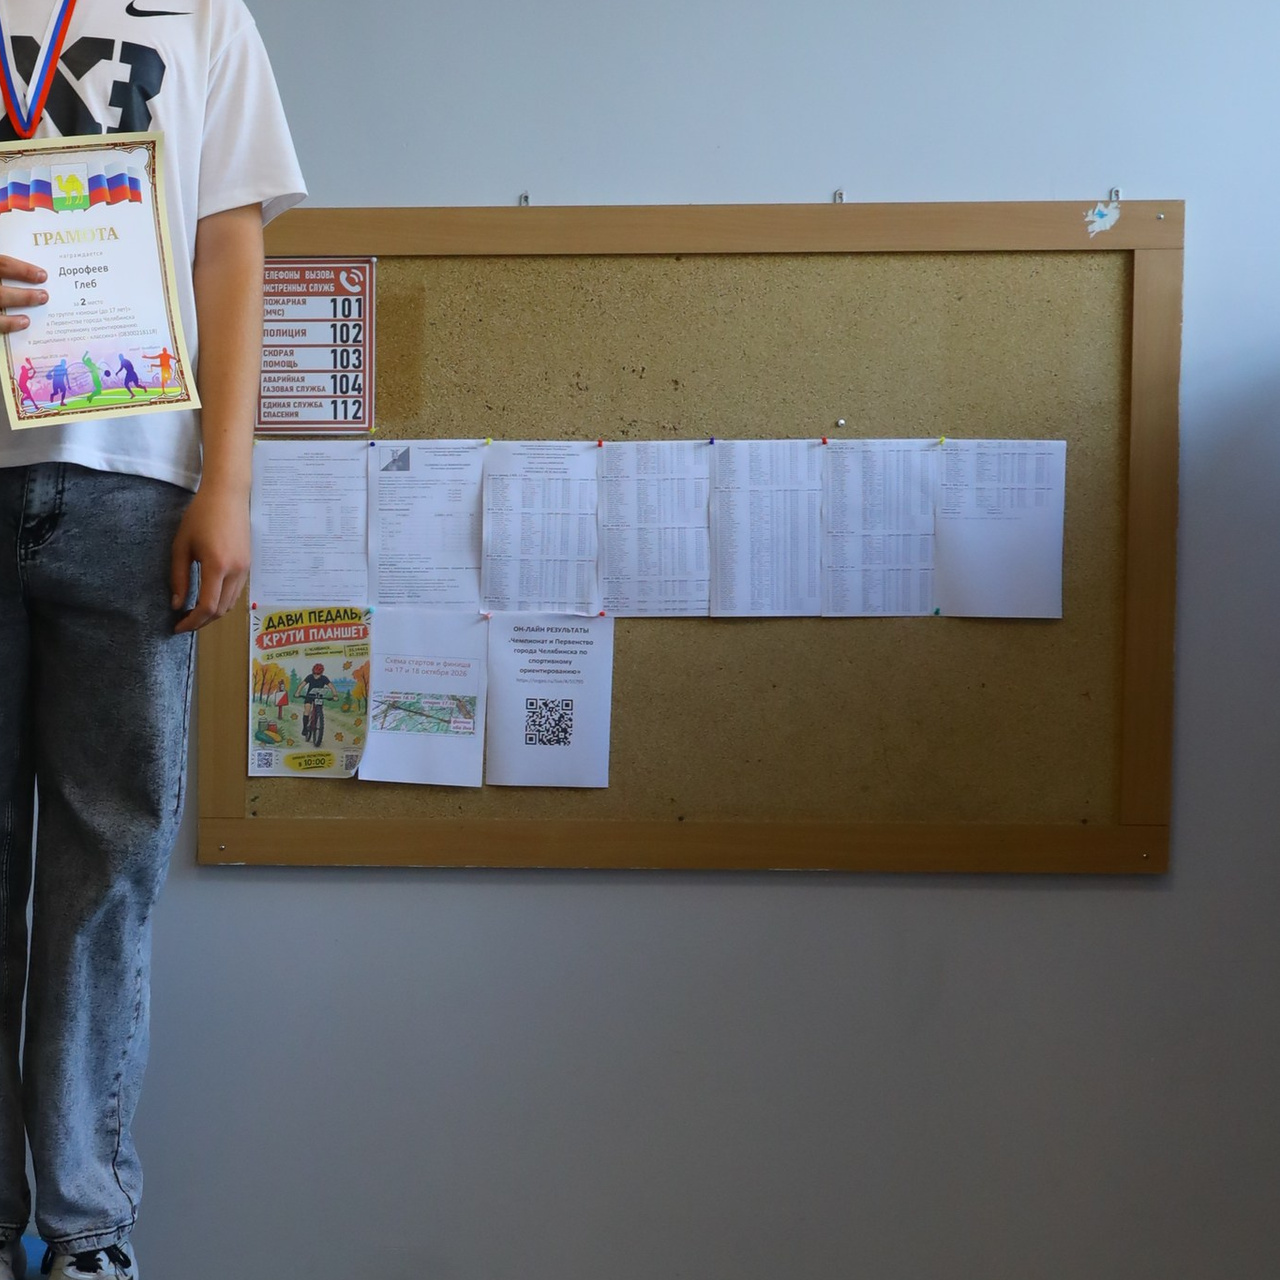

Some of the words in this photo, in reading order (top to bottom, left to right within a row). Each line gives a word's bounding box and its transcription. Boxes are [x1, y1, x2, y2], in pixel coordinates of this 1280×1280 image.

[32, 226, 119, 246] ГРАМОТА
[58, 251, 103, 259] награждается
[58, 265, 109, 277] Дорофеев
[264, 270, 300, 279] ЕЛЕФОНЫ
[305, 270, 335, 279] ВЫЗОВА
[74, 279, 97, 289] Глеб
[309, 283, 335, 292] СЛУЖБ
[80, 298, 86, 306] 2
[263, 309, 285, 317] (МЧС)
[330, 298, 362, 318] 101
[263, 328, 307, 338] ПОЛИЦИЯ
[330, 323, 362, 344] 102
[263, 349, 294, 357] СКОРАЯ
[330, 348, 362, 369] 103
[263, 375, 306, 383] АВАРИЙНАЯ
[330, 374, 362, 395] 104
[330, 399, 362, 420] 112
[265, 613, 304, 631] ДАВИ
[308, 608, 362, 624] ПЕДАЛЬ,
[263, 630, 305, 647] КРУТИ
[309, 625, 365, 640] ПЛАНШЕТ
[275, 650, 299, 658] ОКТЯБРЯ
[304, 758, 326, 766] 10:00
